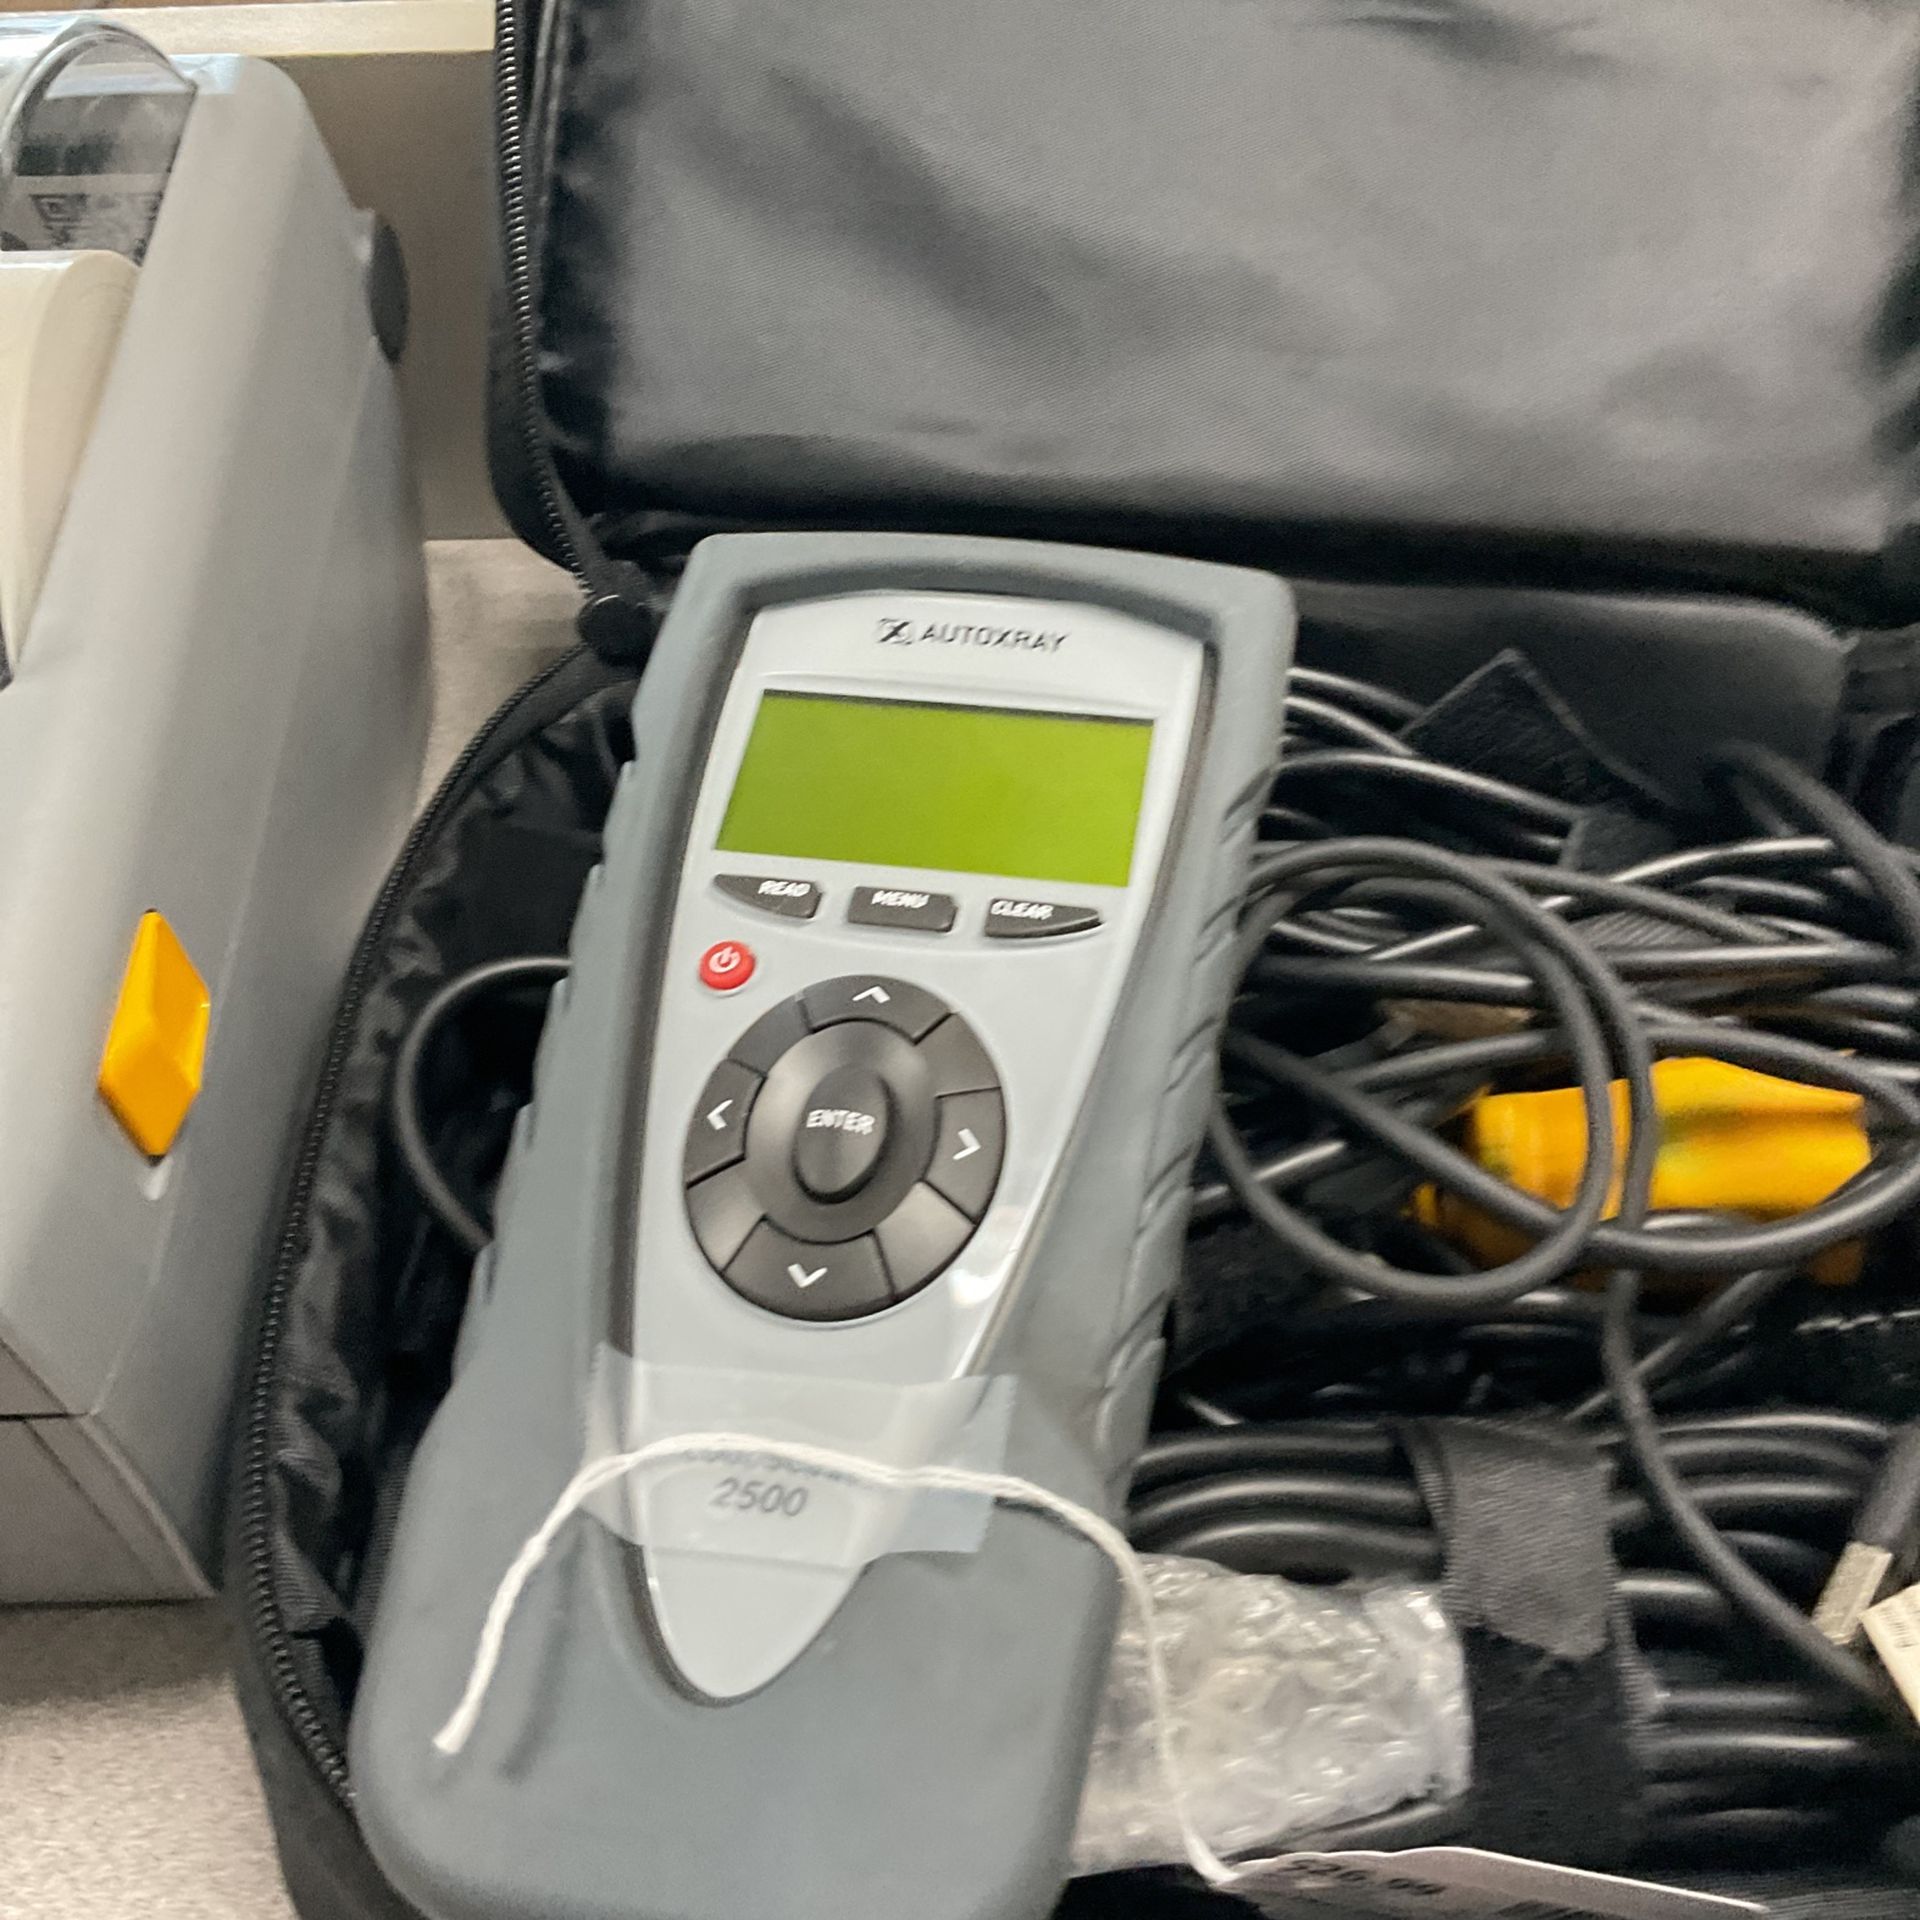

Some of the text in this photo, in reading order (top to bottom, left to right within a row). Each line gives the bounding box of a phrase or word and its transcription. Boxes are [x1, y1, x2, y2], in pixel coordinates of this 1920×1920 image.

[920, 622, 1070, 652] AUTOXRAY
[758, 879, 811, 897] READ
[871, 890, 929, 908] MENU
[991, 900, 1053, 920] CLEAR
[806, 1109, 875, 1135] ENTER
[710, 1476, 808, 1517] 2500
